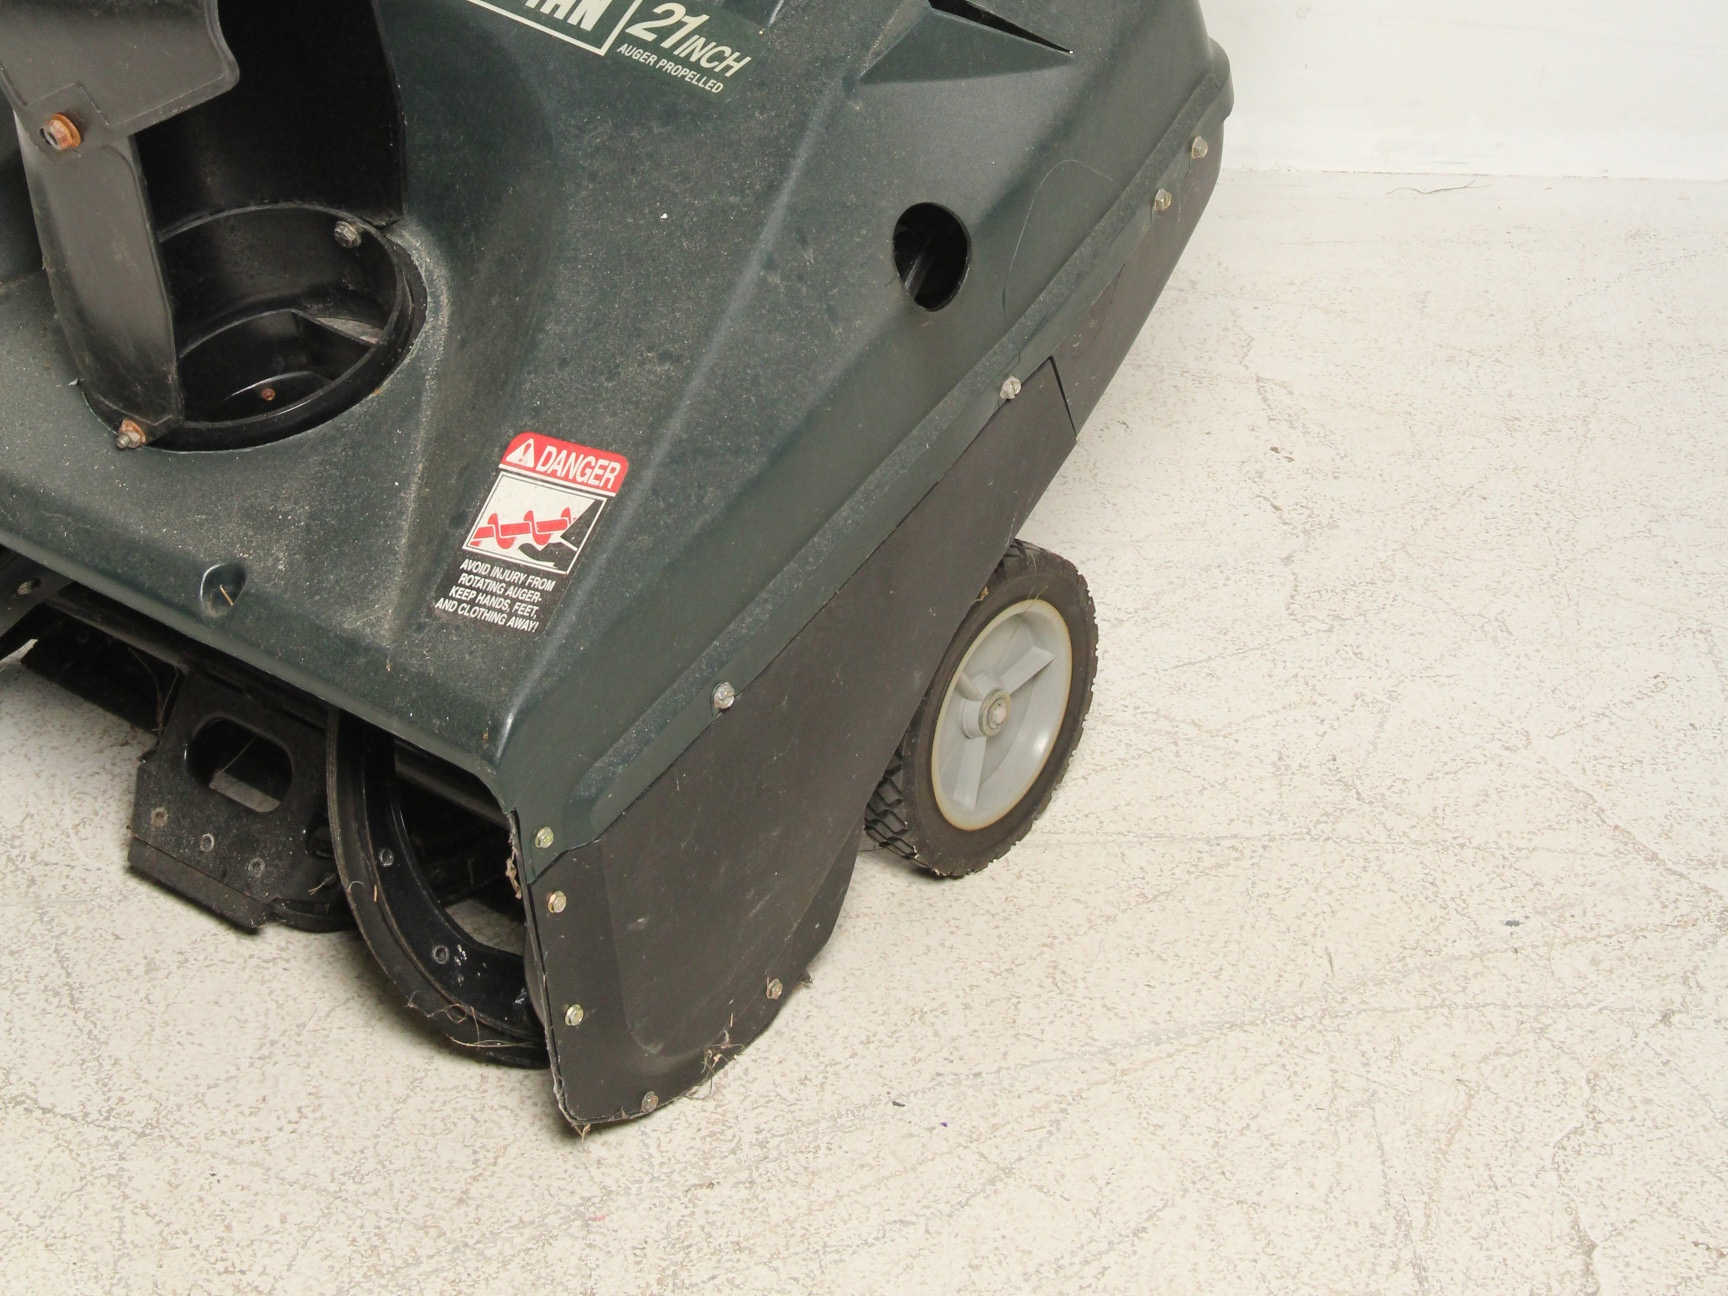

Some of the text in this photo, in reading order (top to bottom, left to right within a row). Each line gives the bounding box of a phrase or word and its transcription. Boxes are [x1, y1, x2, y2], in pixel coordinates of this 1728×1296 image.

[624, 2, 753, 78] 21 INCH
[616, 43, 725, 94] AUGER PROPELLED
[535, 445, 621, 489] DANGER
[457, 572, 507, 595] ROTATING
[459, 558, 557, 592] AVOID INJURY FROM
[434, 597, 540, 634] AND CLOTHING AWAY!
[448, 585, 540, 620] KEEP HANDS, FEET,
